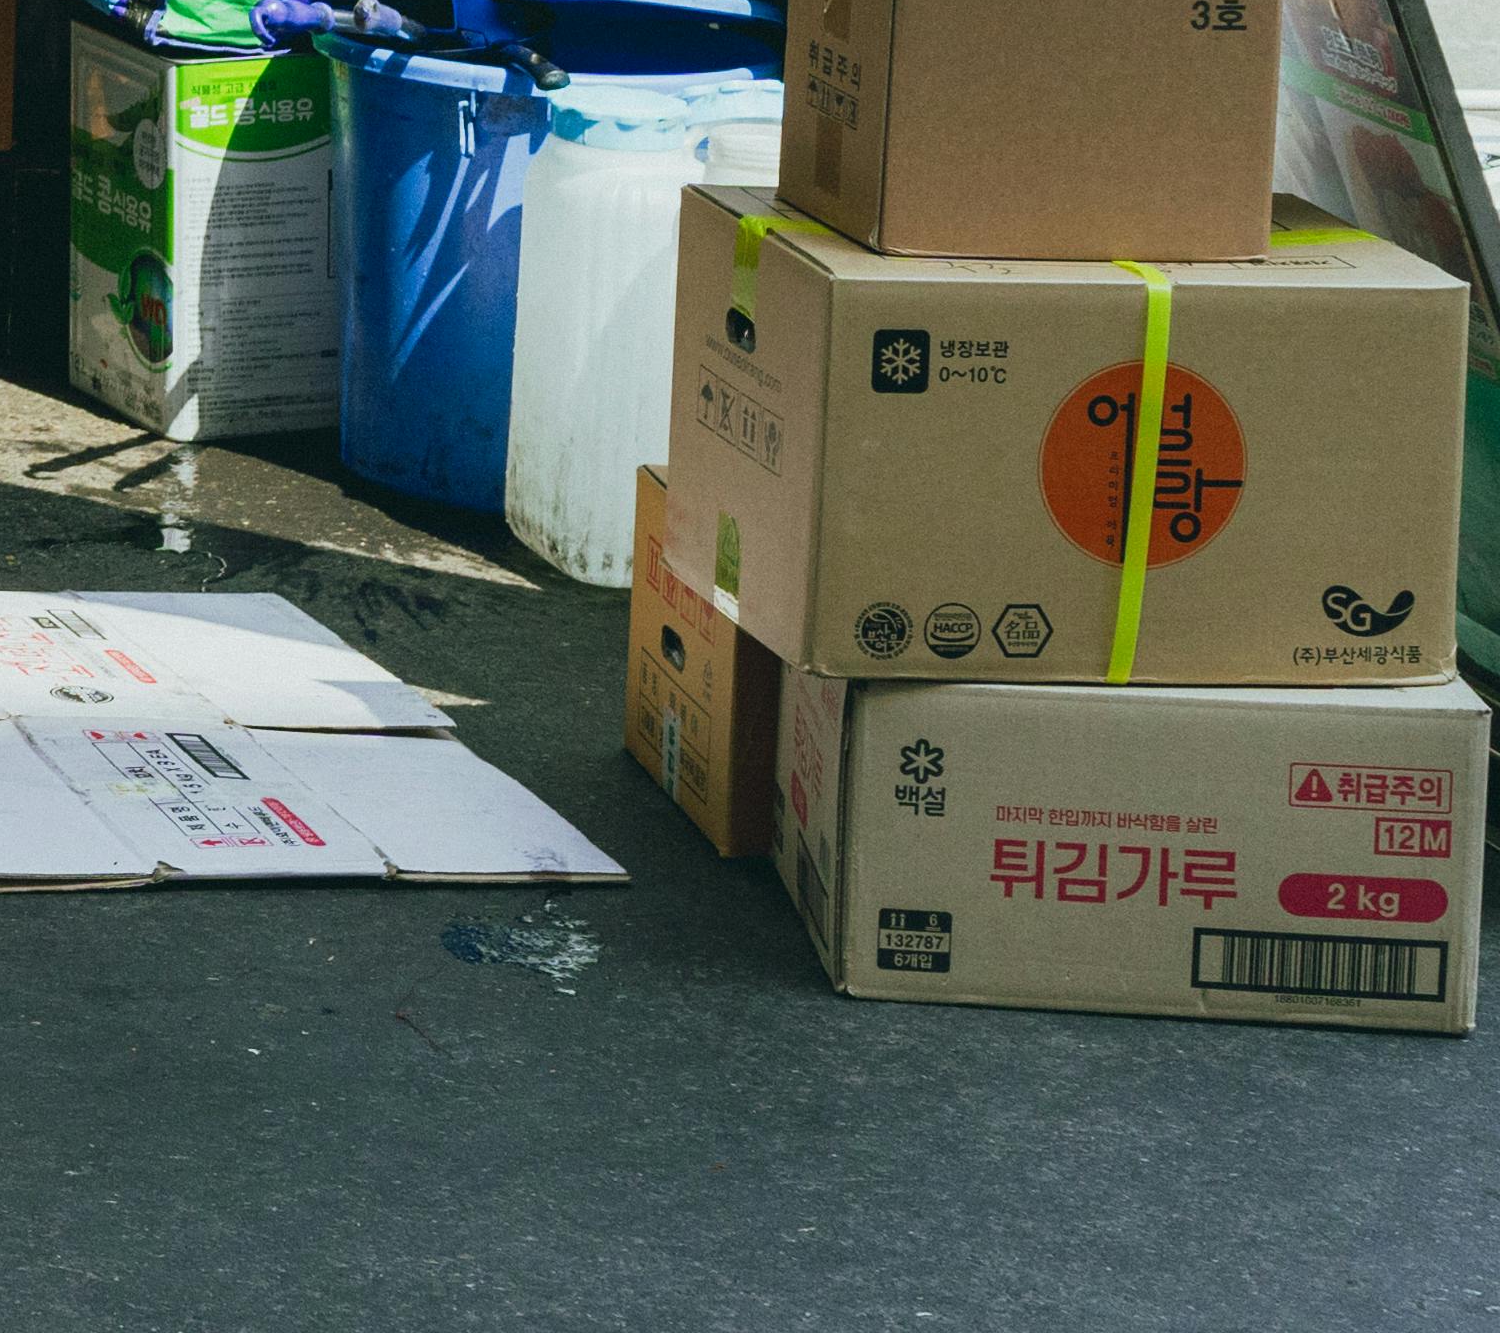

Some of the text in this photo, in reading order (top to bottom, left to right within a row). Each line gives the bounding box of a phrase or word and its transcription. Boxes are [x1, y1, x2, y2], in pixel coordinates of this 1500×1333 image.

[1190, 0, 1248, 32] 3호
[808, 39, 861, 92] 취급주의
[939, 339, 1010, 360] 냉장보관
[1327, 592, 1373, 630] SG
[933, 622, 974, 634] HACCP
[1003, 620, 1040, 641] 名品
[1293, 644, 1422, 666] (주)부산세광식품
[894, 783, 948, 817] 백설
[1337, 772, 1443, 808] 취급주의
[996, 805, 1219, 835] 마지막 한입까지 바삭함을 살린
[989, 838, 1239, 911] 튀김가루
[1327, 884, 1401, 916] 2 kg
[883, 933, 945, 951] 132787
[894, 952, 934, 970] 6개입
